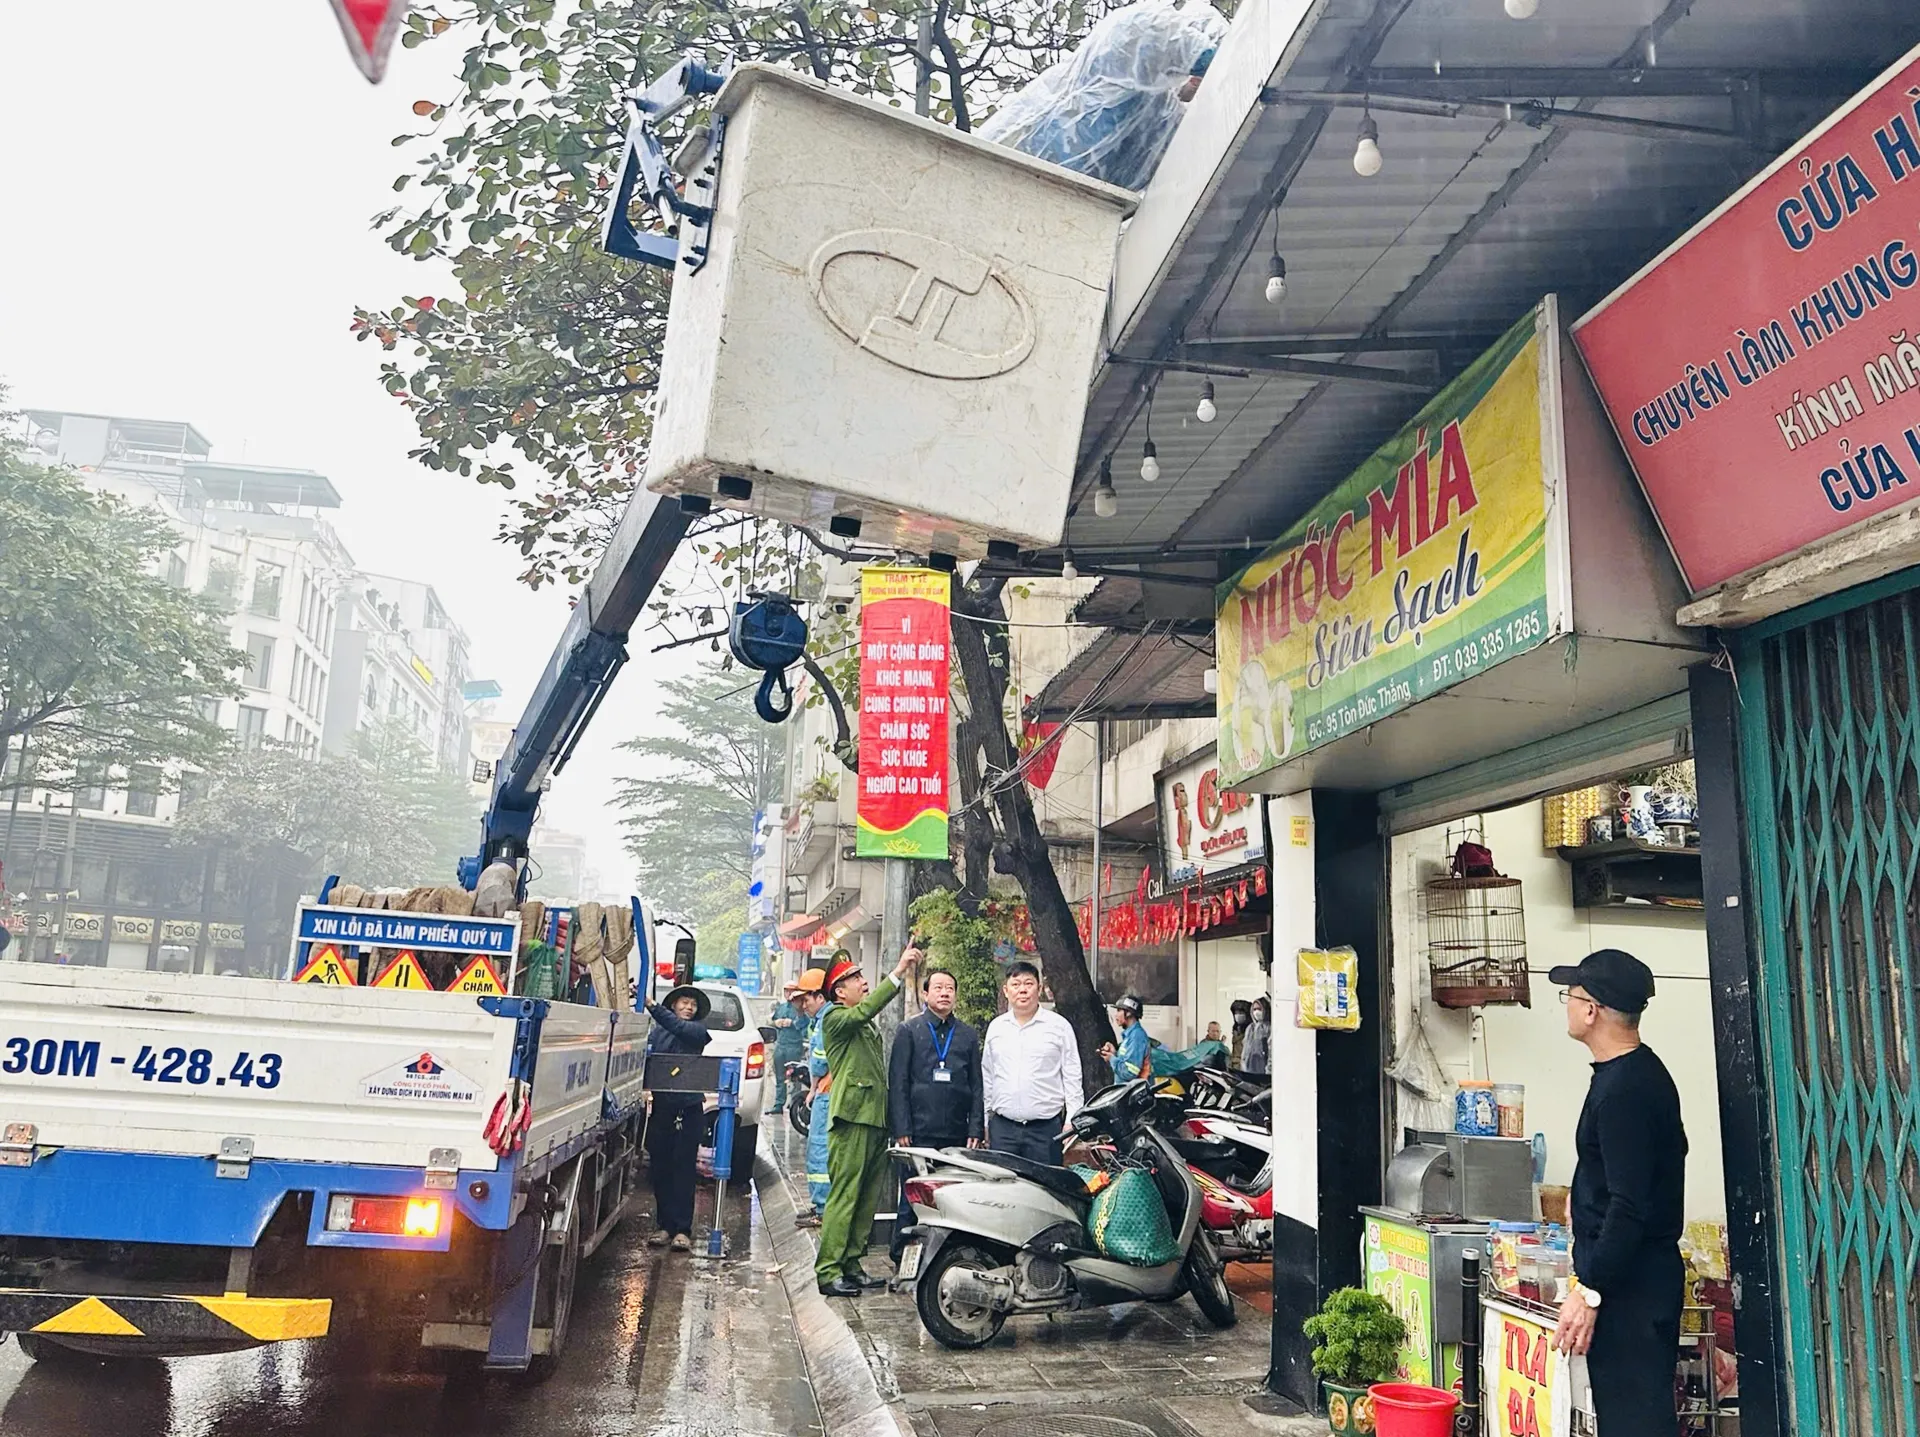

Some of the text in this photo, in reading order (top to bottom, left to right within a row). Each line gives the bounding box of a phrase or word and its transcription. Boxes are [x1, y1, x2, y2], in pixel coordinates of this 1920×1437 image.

[1776, 156, 1879, 252] CỬA
[1632, 240, 1918, 447] CHUYÊN LÀM KHUNG
[1774, 376, 1863, 452] KÍNH
[1818, 437, 1909, 513] CỬA
[1240, 417, 1479, 664] NƯỚC MÍA
[1306, 527, 1485, 691] Siêu Sạch
[867, 642, 945, 662] MỘT CỘNG ĐỒNG
[876, 667, 935, 689] KHỎE MẠNH,
[1326, 714, 1338, 733] 95
[1338, 706, 1357, 727] Tôn
[1358, 697, 1377, 720] Đức
[1377, 677, 1411, 709] Thắng
[1432, 657, 1453, 682] ĐT:
[1454, 644, 1479, 672] 039
[1480, 630, 1505, 659] 335
[1505, 610, 1541, 647] 1265
[864, 695, 945, 715] CÙNG CHUNG TAY
[879, 720, 930, 741] CHĂM SÓC
[881, 744, 928, 767] SỨC KHỎE
[866, 770, 942, 795] NGƯỜI CAO TUỔI
[66, 917, 99, 930] TQQ
[117, 921, 149, 934] TQQ
[166, 924, 196, 937] TQQ
[215, 927, 242, 940] TQQ
[313, 918, 503, 950] XIN LỖI ĐÃ LÀM PHIỀN QUÝ VỊ
[475, 968, 485, 979] ĐI
[422, 1090, 427, 1098] &
[465, 1092, 473, 1100] 68
[1505, 1321, 1547, 1388] TRÀ
[1507, 1386, 1540, 1437] ĐÁ
